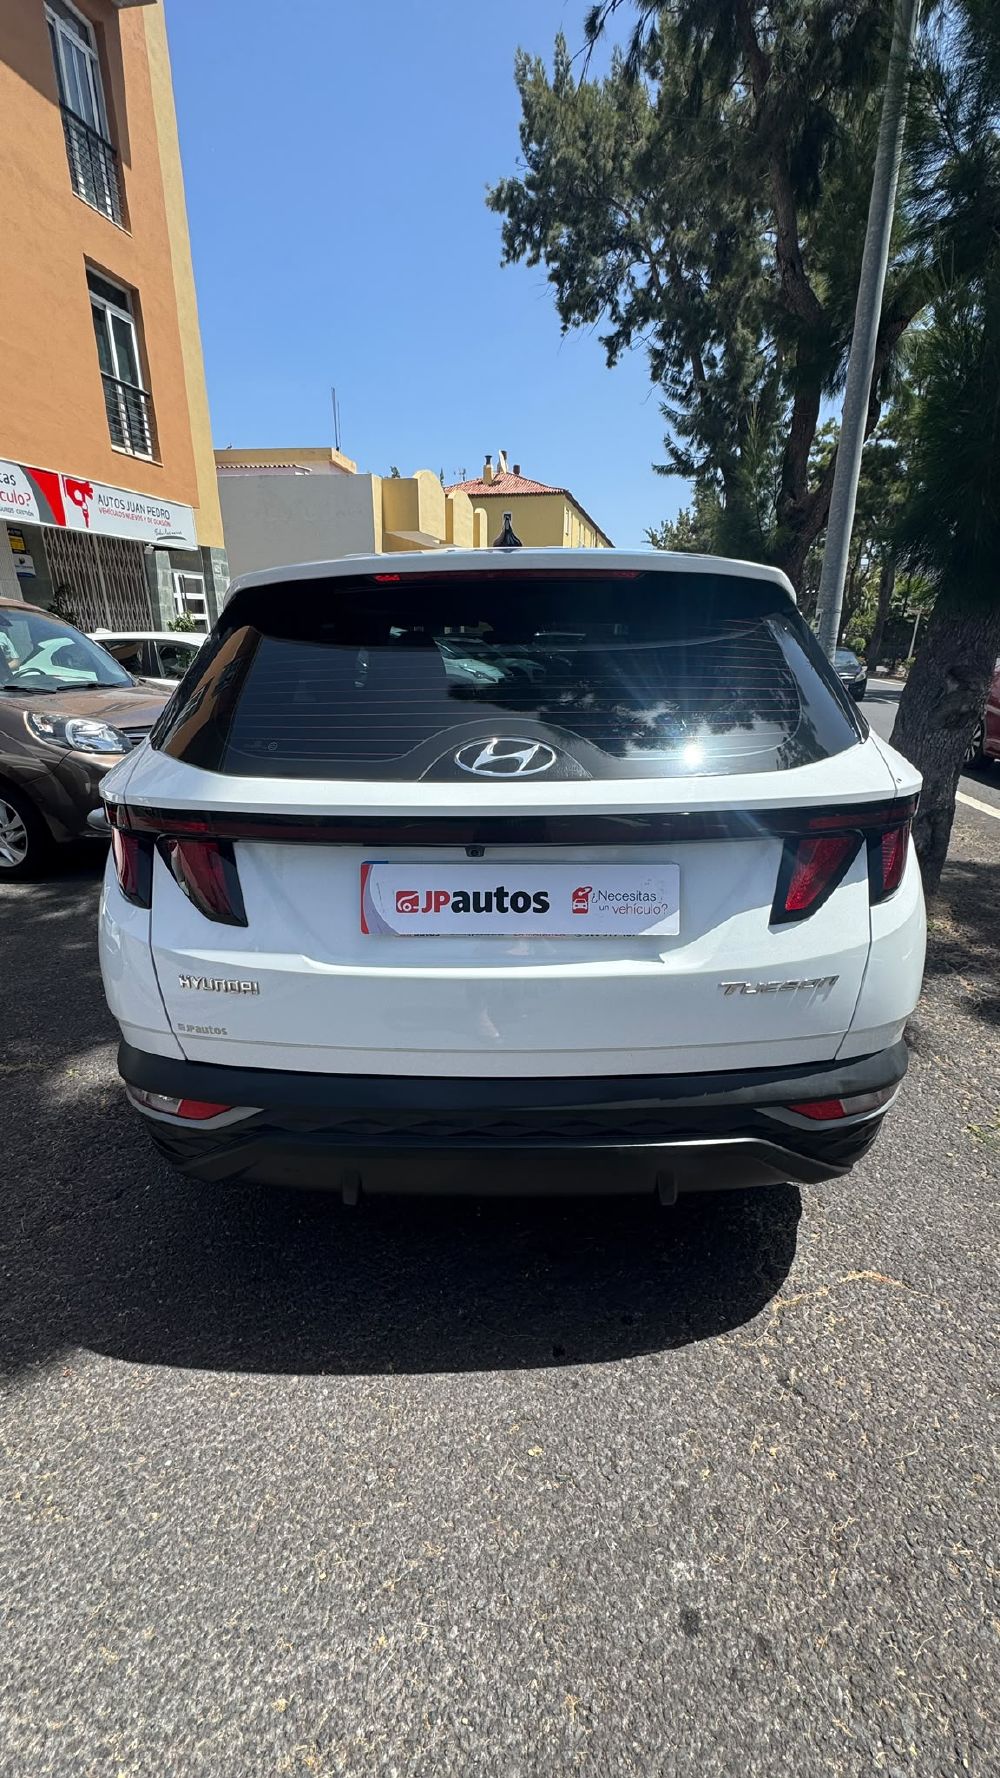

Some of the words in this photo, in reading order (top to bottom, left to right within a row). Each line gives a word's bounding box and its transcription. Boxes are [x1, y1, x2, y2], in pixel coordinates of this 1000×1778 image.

[98, 494, 125, 510] AUTOS
[127, 501, 145, 514] JUAN
[147, 506, 170, 520] PEDRO
[421, 886, 550, 913] JPautos
[591, 889, 657, 904] ¿Necesitas
[612, 903, 668, 915] vehículo?
[179, 974, 260, 995] HYUNDAI
